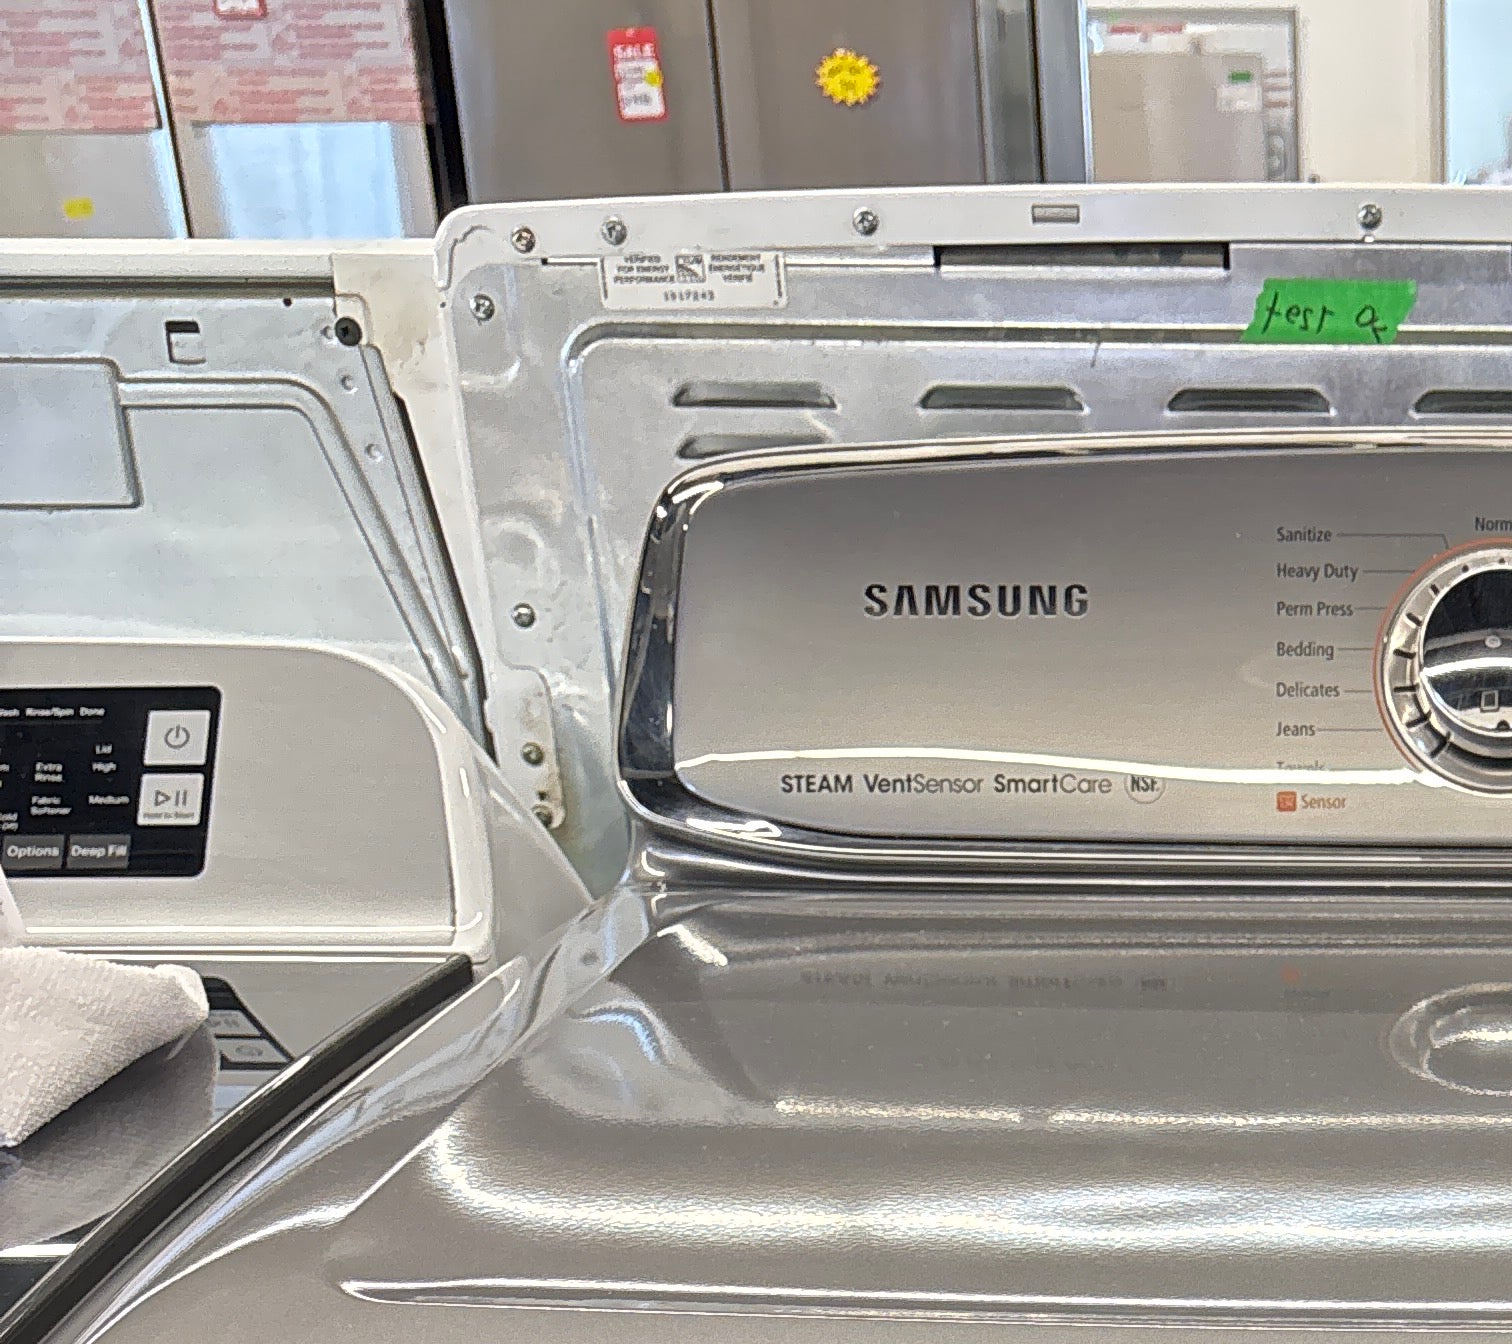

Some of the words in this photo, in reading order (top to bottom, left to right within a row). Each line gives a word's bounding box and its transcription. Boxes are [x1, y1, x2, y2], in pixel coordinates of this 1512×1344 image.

[1276, 526, 1332, 543] Sanitize
[1276, 563, 1320, 582] Heavy
[1323, 563, 1359, 582] Duty
[863, 583, 1088, 618] SAMSUNG
[1276, 601, 1313, 616] Perm
[1317, 601, 1354, 617] Press
[1276, 641, 1335, 660] Bedding
[1276, 681, 1341, 698] Delicates
[1276, 721, 1316, 737] Jeans
[781, 773, 853, 793] STEAM
[862, 773, 982, 794] VentSensor
[994, 774, 1112, 794] SmartCare
[1301, 794, 1346, 809] Sensor
[7, 845, 59, 859] Options
[71, 845, 106, 859] Deep
[108, 844, 127, 857] Fill
